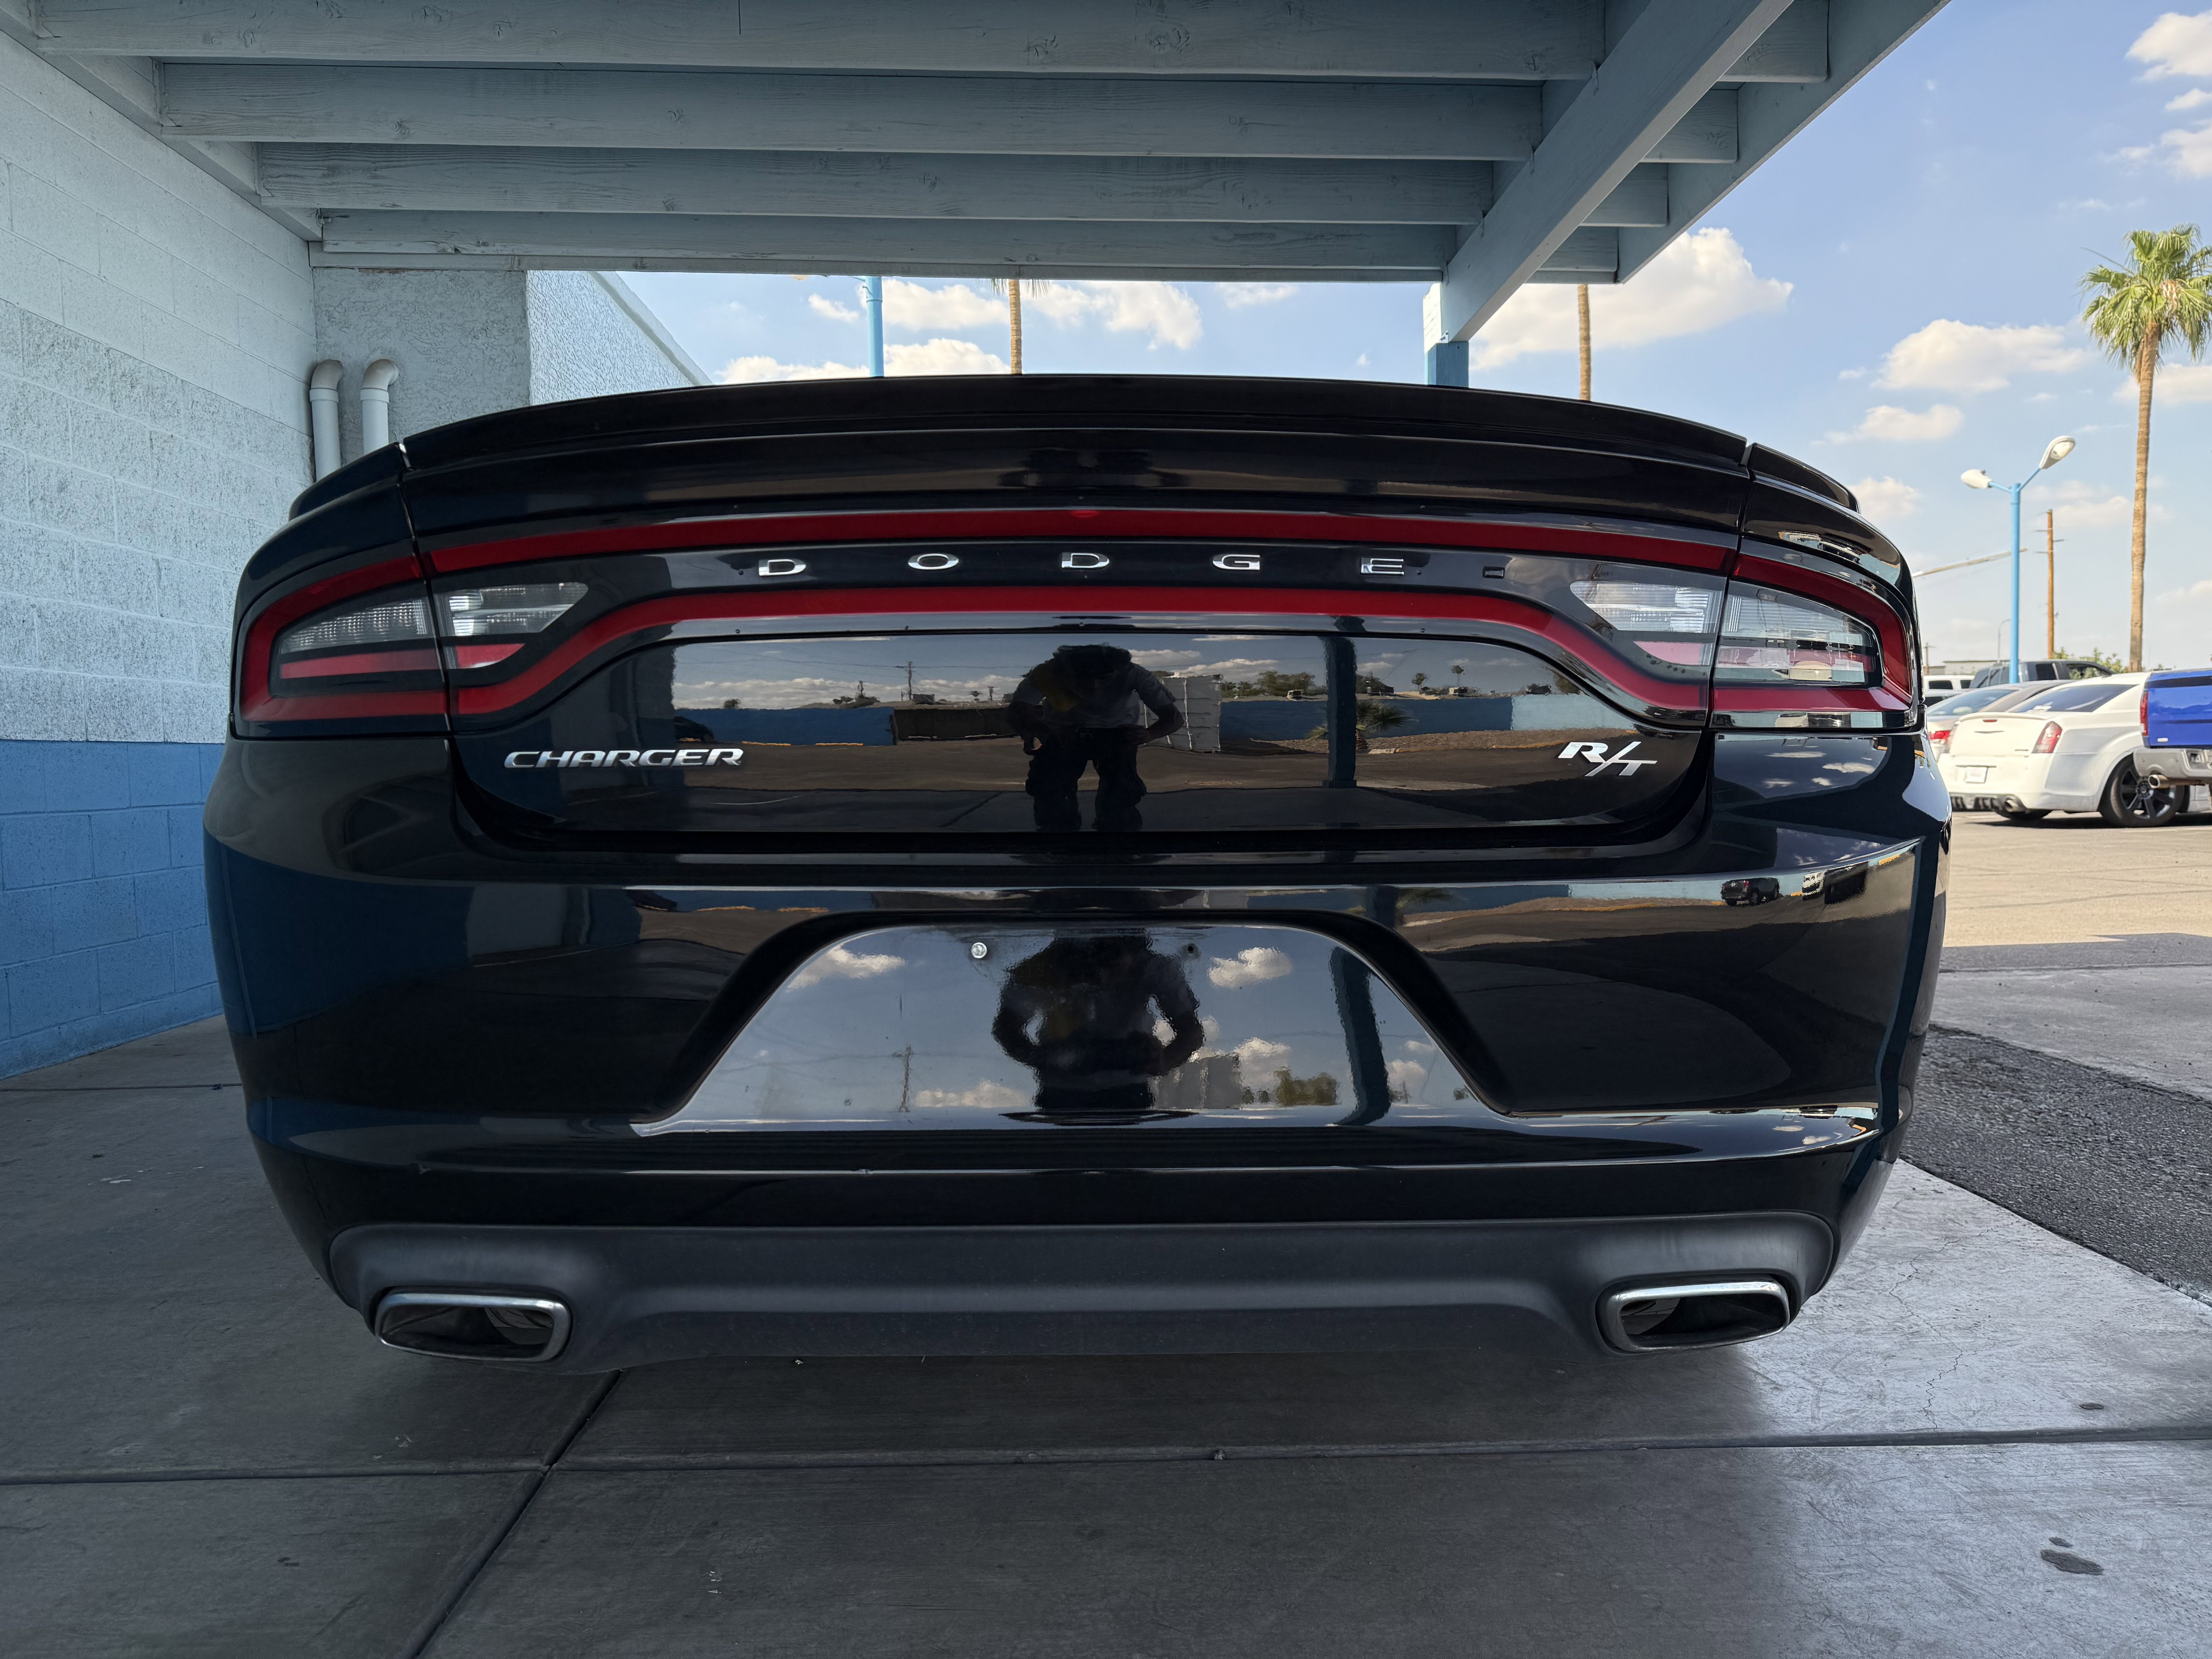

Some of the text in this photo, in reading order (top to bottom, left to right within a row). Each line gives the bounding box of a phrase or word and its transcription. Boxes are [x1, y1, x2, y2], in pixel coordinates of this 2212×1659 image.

[758, 551, 1405, 576] DODGE
[504, 748, 744, 768] CHARGER
[1558, 741, 1658, 776] R/T
